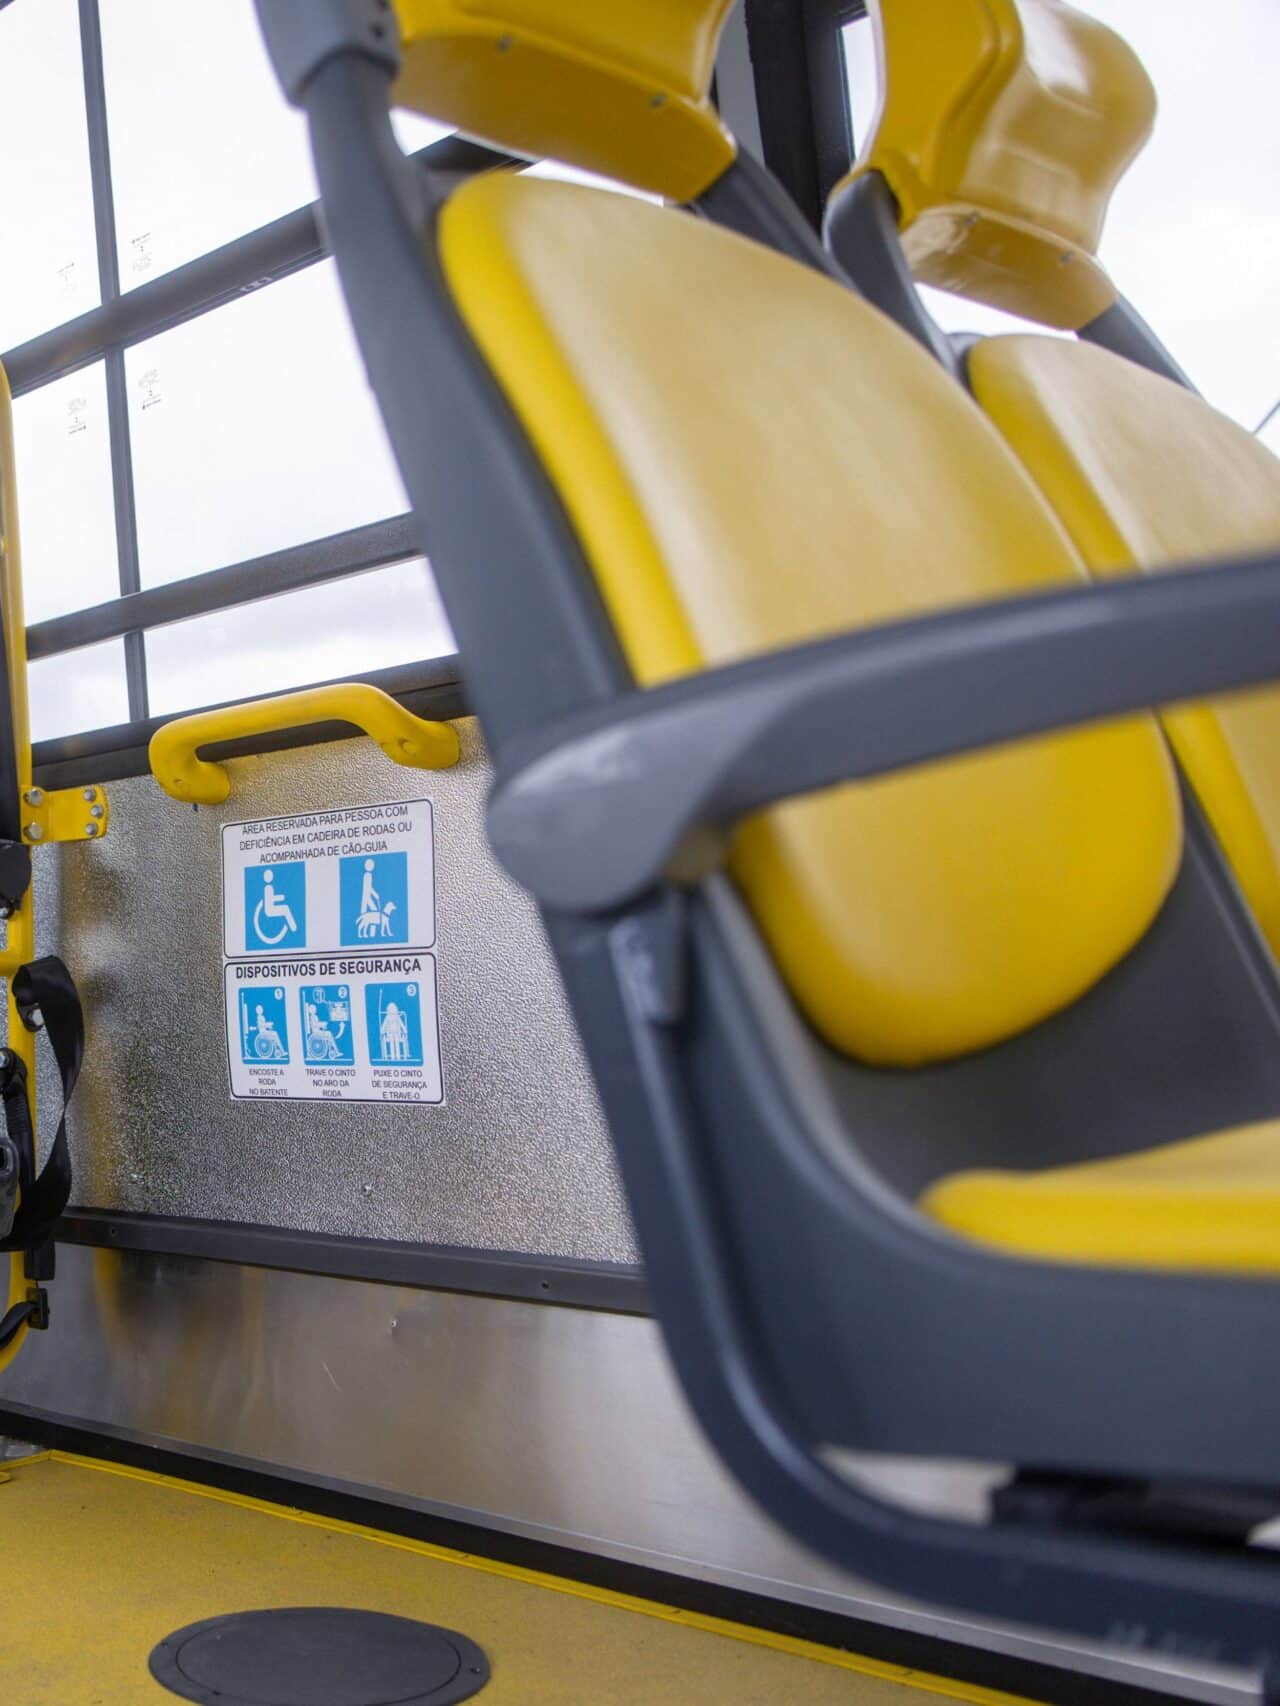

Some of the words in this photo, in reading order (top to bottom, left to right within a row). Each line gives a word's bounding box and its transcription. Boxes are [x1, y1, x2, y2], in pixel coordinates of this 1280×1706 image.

[266, 816, 318, 833] RESERVADA
[320, 813, 344, 826] PARA
[345, 808, 384, 822] PESSOA
[385, 805, 408, 818] COM
[240, 836, 291, 851] DEFICIÊNCIA
[292, 834, 305, 845] EM
[307, 827, 346, 843] CADEIRA
[347, 826, 360, 839] DE
[362, 822, 396, 837] RODAS
[398, 820, 412, 833] OU
[260, 847, 326, 864] ACOMPANHADA
[327, 845, 340, 857] DE
[342, 841, 388, 855] CÃO-GUIA
[236, 963, 316, 979] DISPOSITIVOS
[320, 961, 336, 976] DE
[339, 958, 422, 975] SEGURANÇA
[249, 1068, 278, 1076] ENCOSTE
